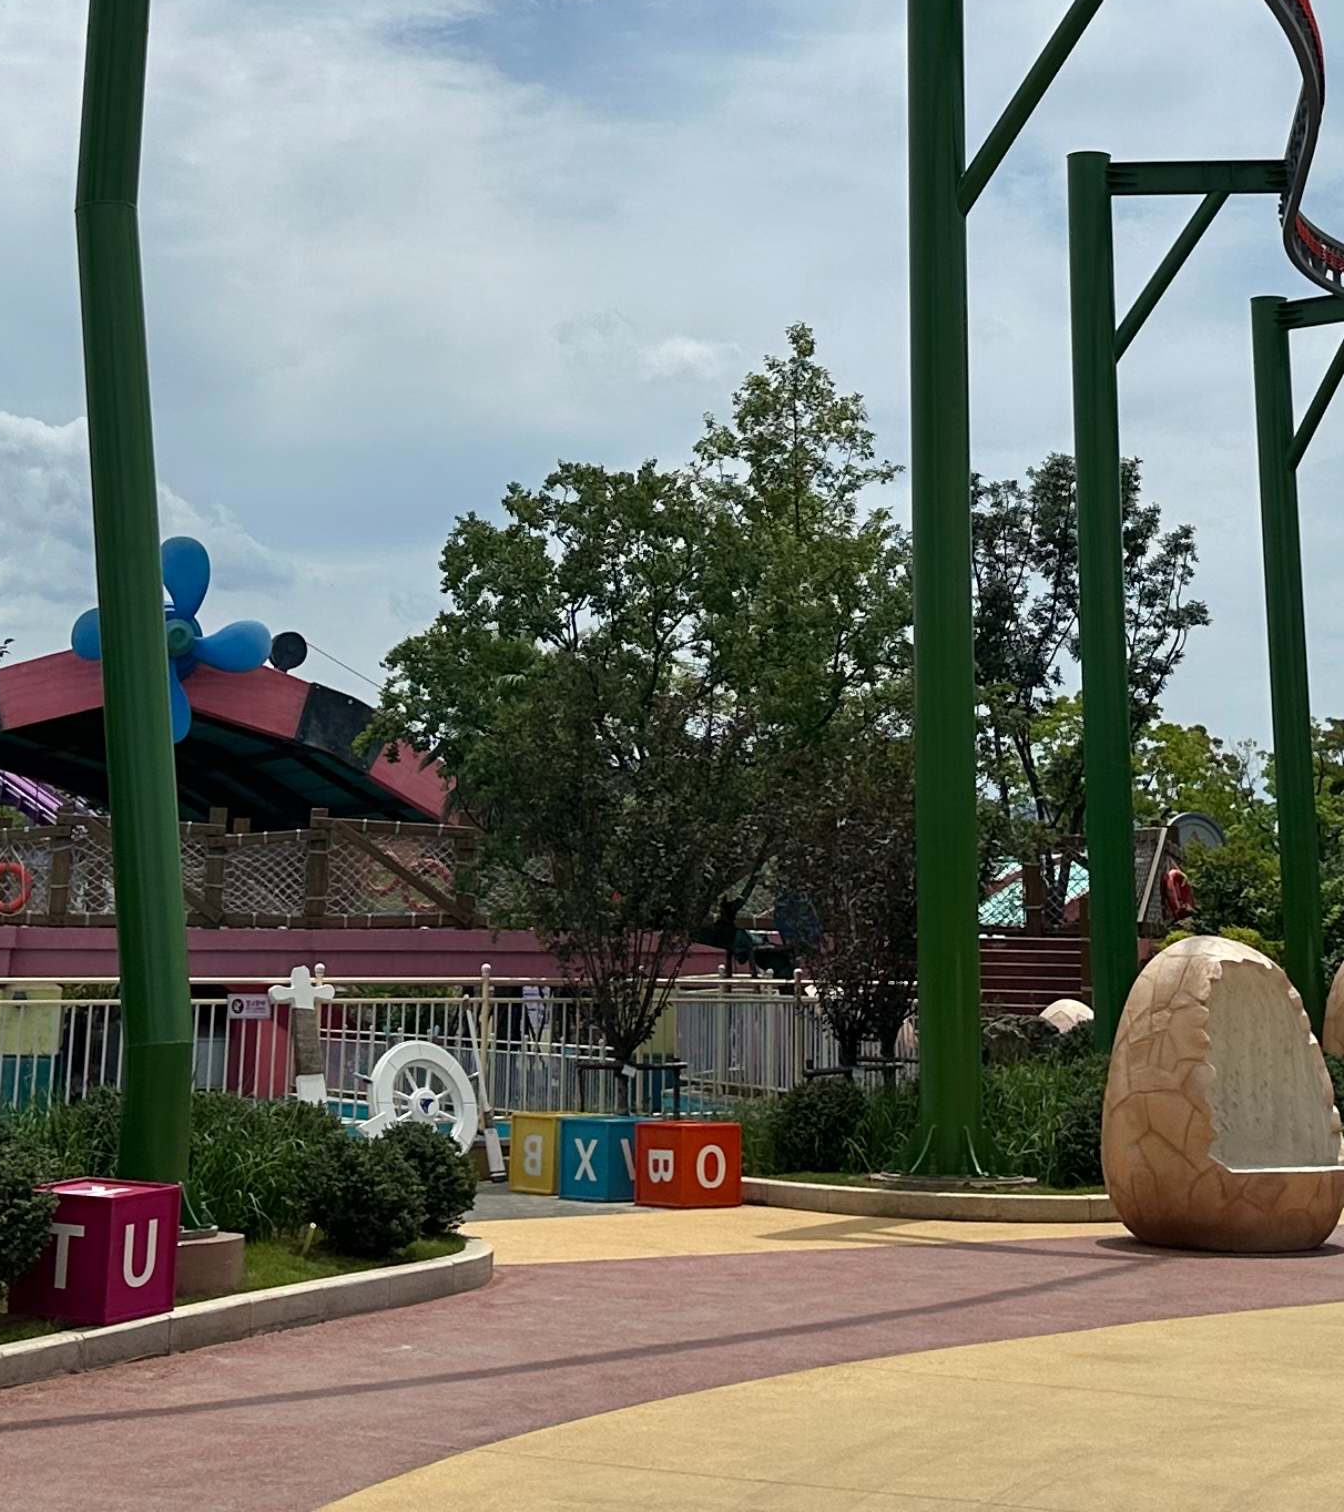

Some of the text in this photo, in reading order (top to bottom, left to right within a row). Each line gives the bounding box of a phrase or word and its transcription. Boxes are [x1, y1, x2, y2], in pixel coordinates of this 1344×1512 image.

[574, 1138, 598, 1182] X
[648, 1149, 674, 1184] B
[696, 1144, 727, 1189] O
[49, 1222, 85, 1289] T
[123, 1218, 158, 1288] U
